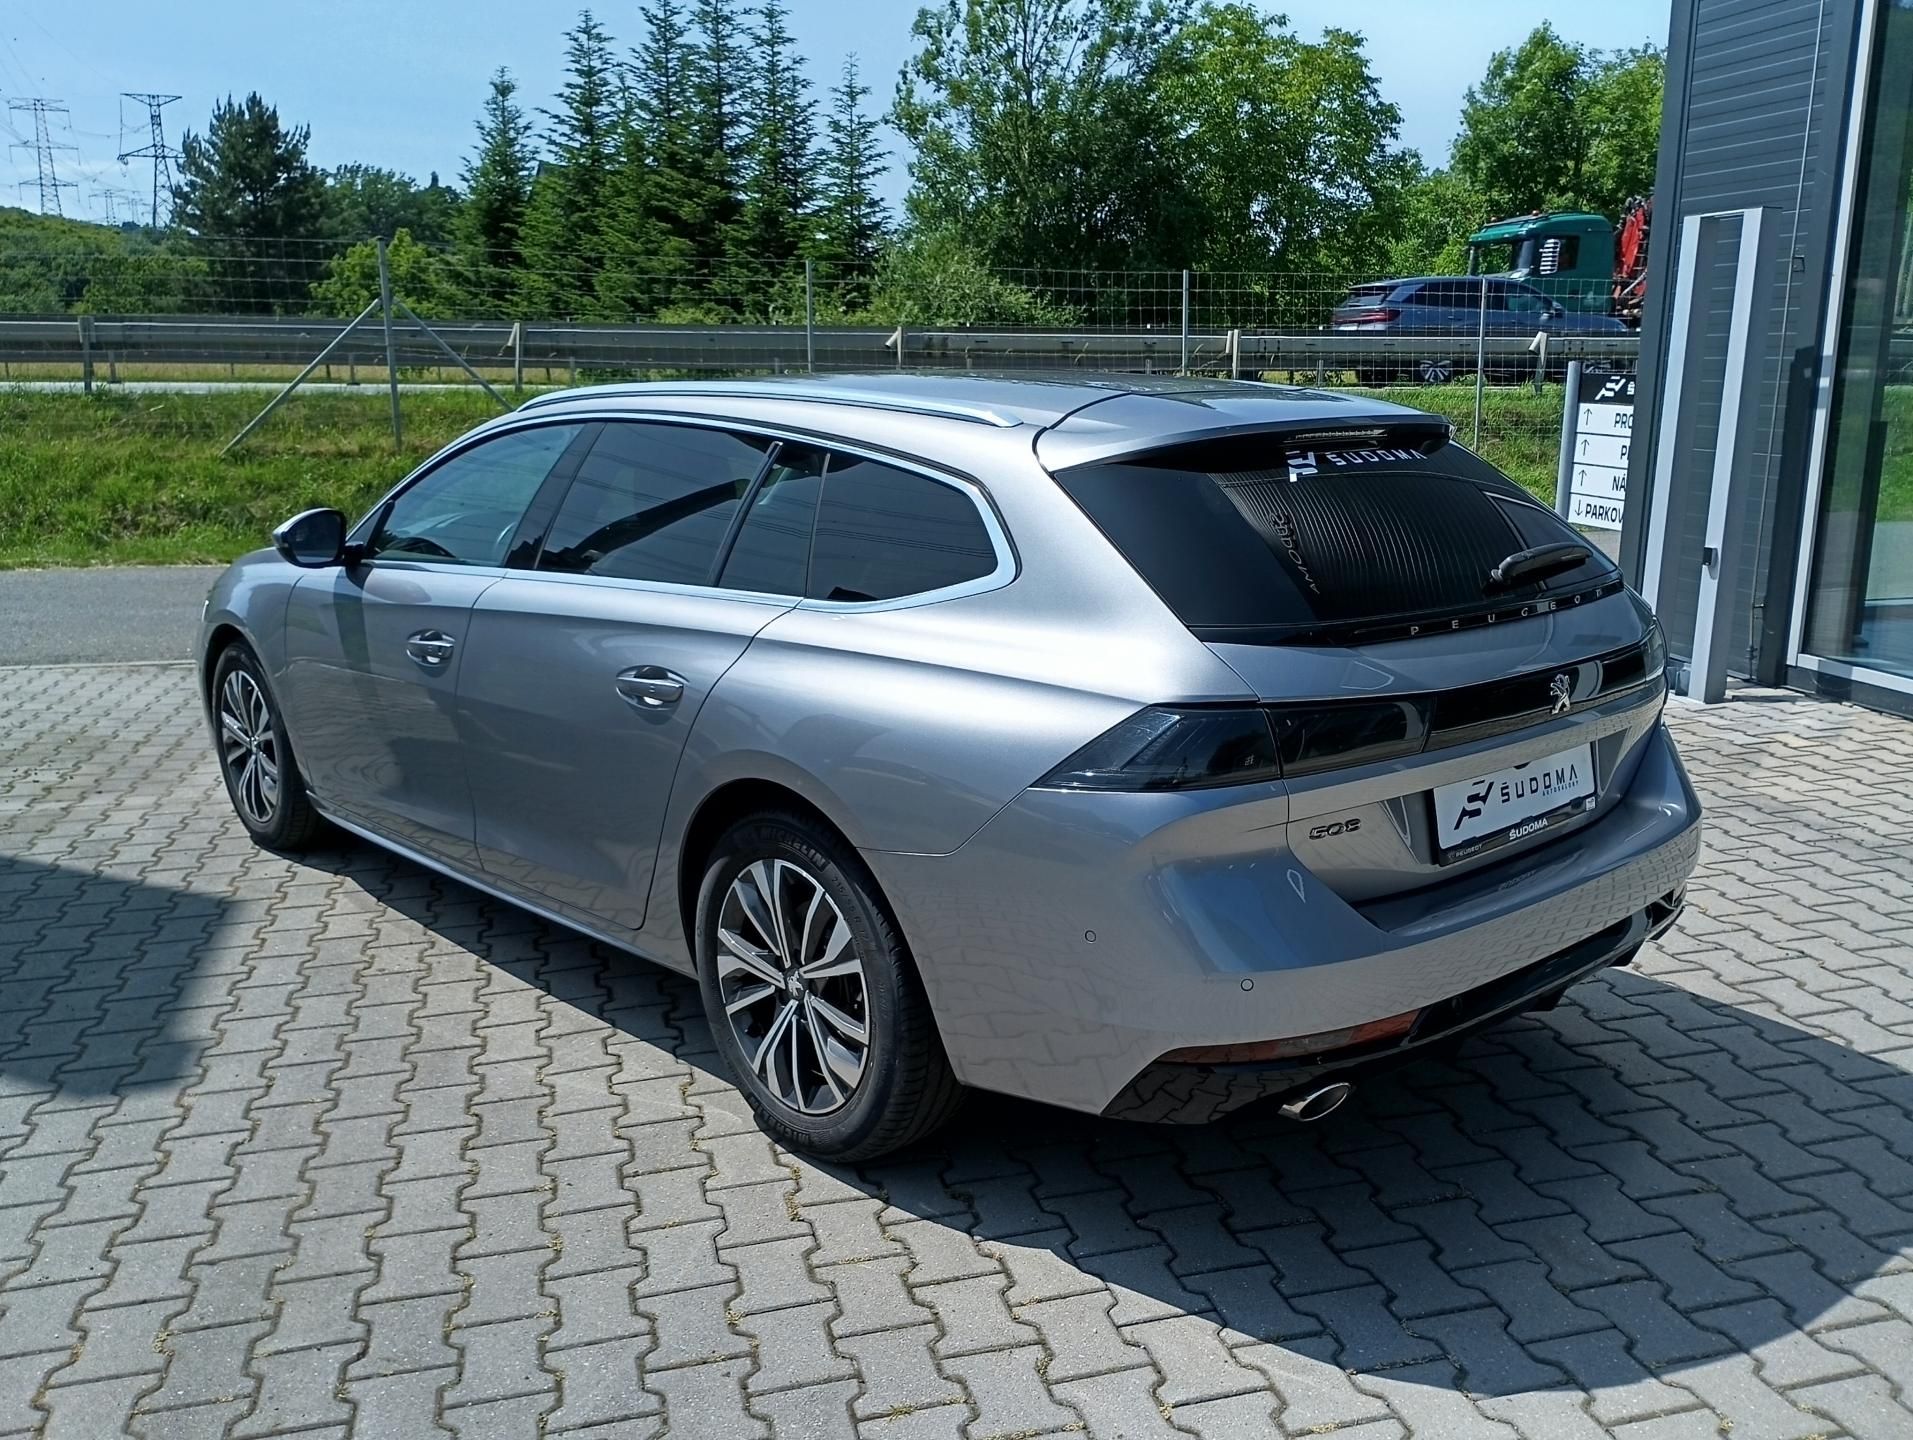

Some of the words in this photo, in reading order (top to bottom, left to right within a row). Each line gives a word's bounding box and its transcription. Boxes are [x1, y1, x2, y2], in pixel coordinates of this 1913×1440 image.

[1410, 588, 1603, 635] PEUGEOT
[1500, 763, 1578, 803] ŠUDOMA
[1308, 818, 1361, 840] 508
[1509, 818, 1548, 840] ŠUDOMA
